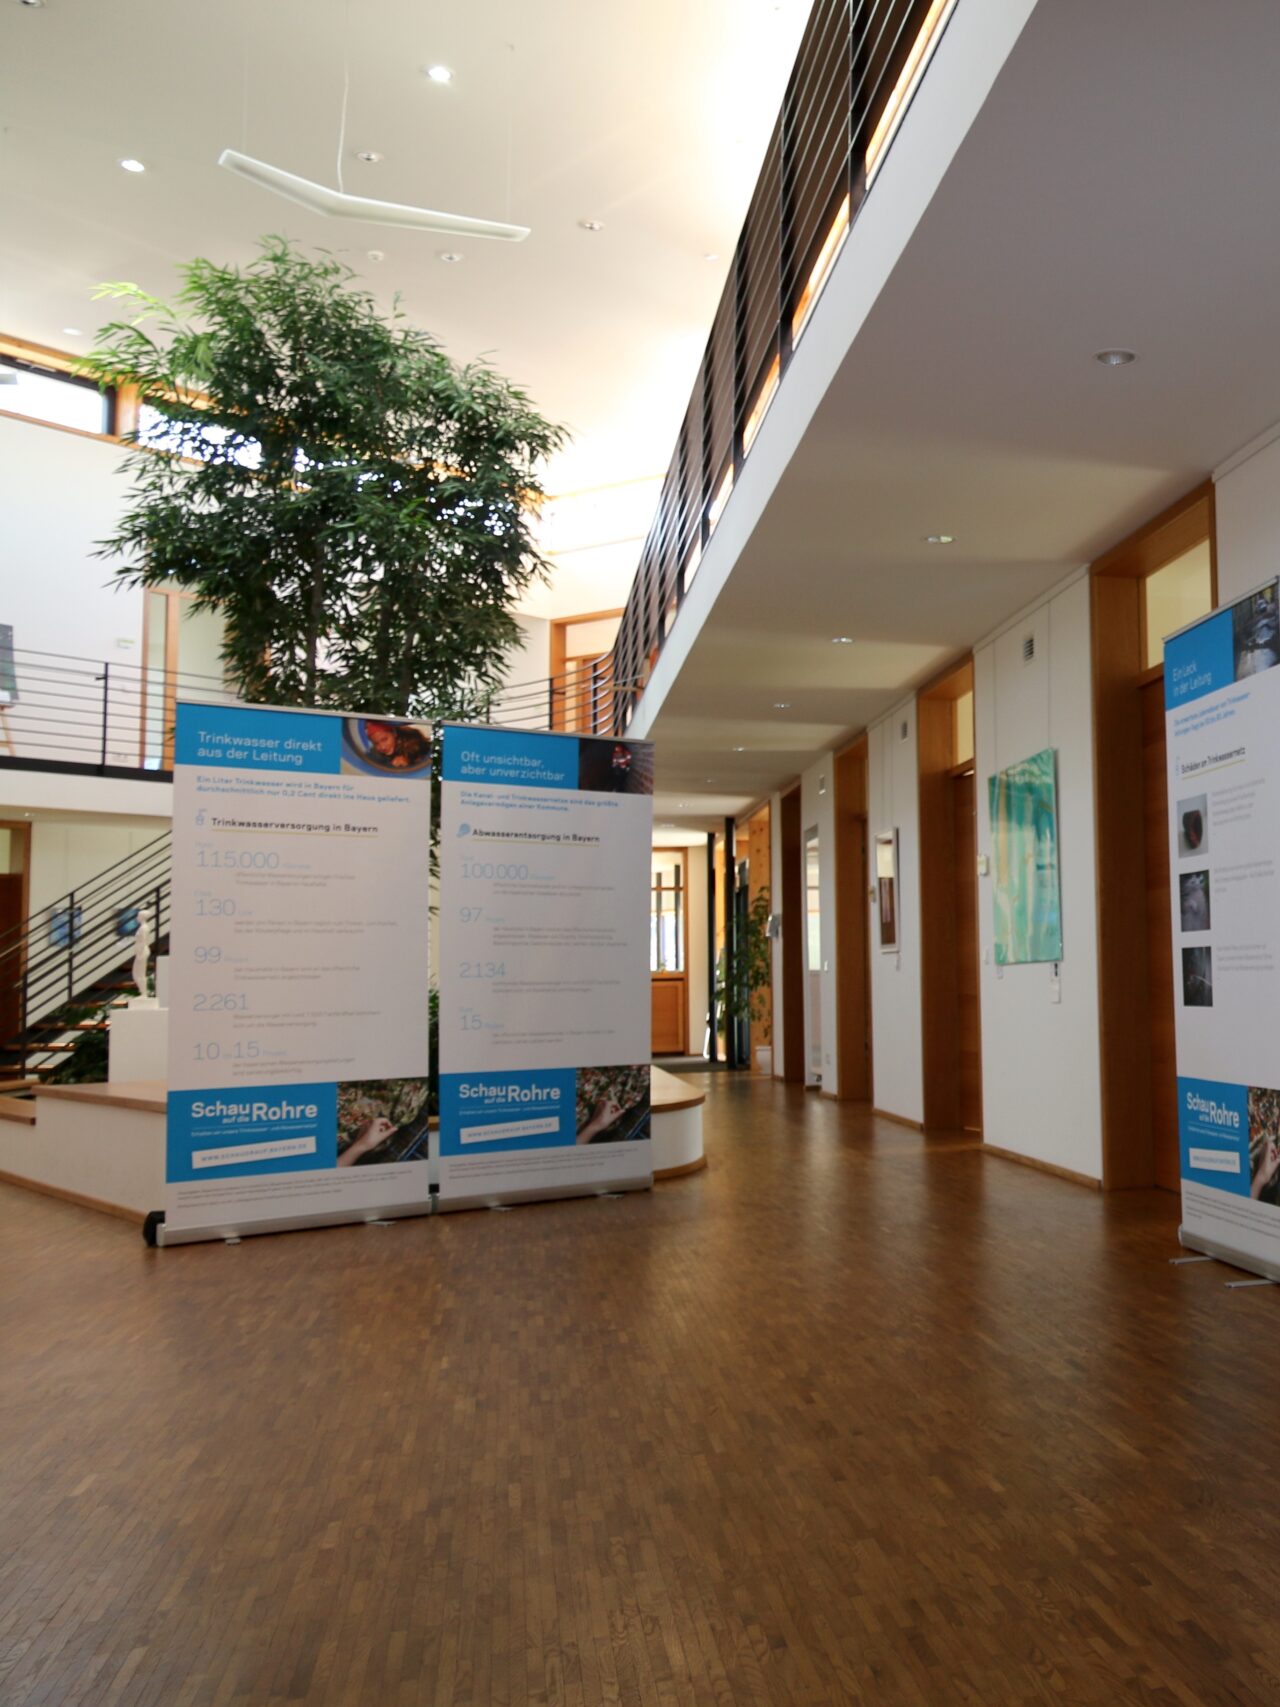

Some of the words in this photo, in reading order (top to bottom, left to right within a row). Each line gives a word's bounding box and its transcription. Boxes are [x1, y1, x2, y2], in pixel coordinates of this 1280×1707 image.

[197, 730, 281, 749] Trinkwasser
[282, 737, 322, 752] direkt
[196, 746, 224, 758] aus
[225, 746, 249, 760] der
[251, 749, 304, 766] Leitung
[460, 750, 481, 763] Oft
[459, 763, 487, 776] aber
[488, 766, 565, 781] unverzichtbar
[211, 817, 331, 832] Trinkwasserversorgung
[332, 823, 341, 831] in
[343, 823, 378, 833] Bayern
[194, 897, 237, 917] 130
[458, 1081, 508, 1099] Schau
[506, 1082, 561, 1103] Rohre
[190, 1099, 251, 1119] Schau
[251, 1099, 318, 1122] Rohre
[1186, 1091, 1210, 1113] Schau
[1208, 1100, 1240, 1128] Rohre
